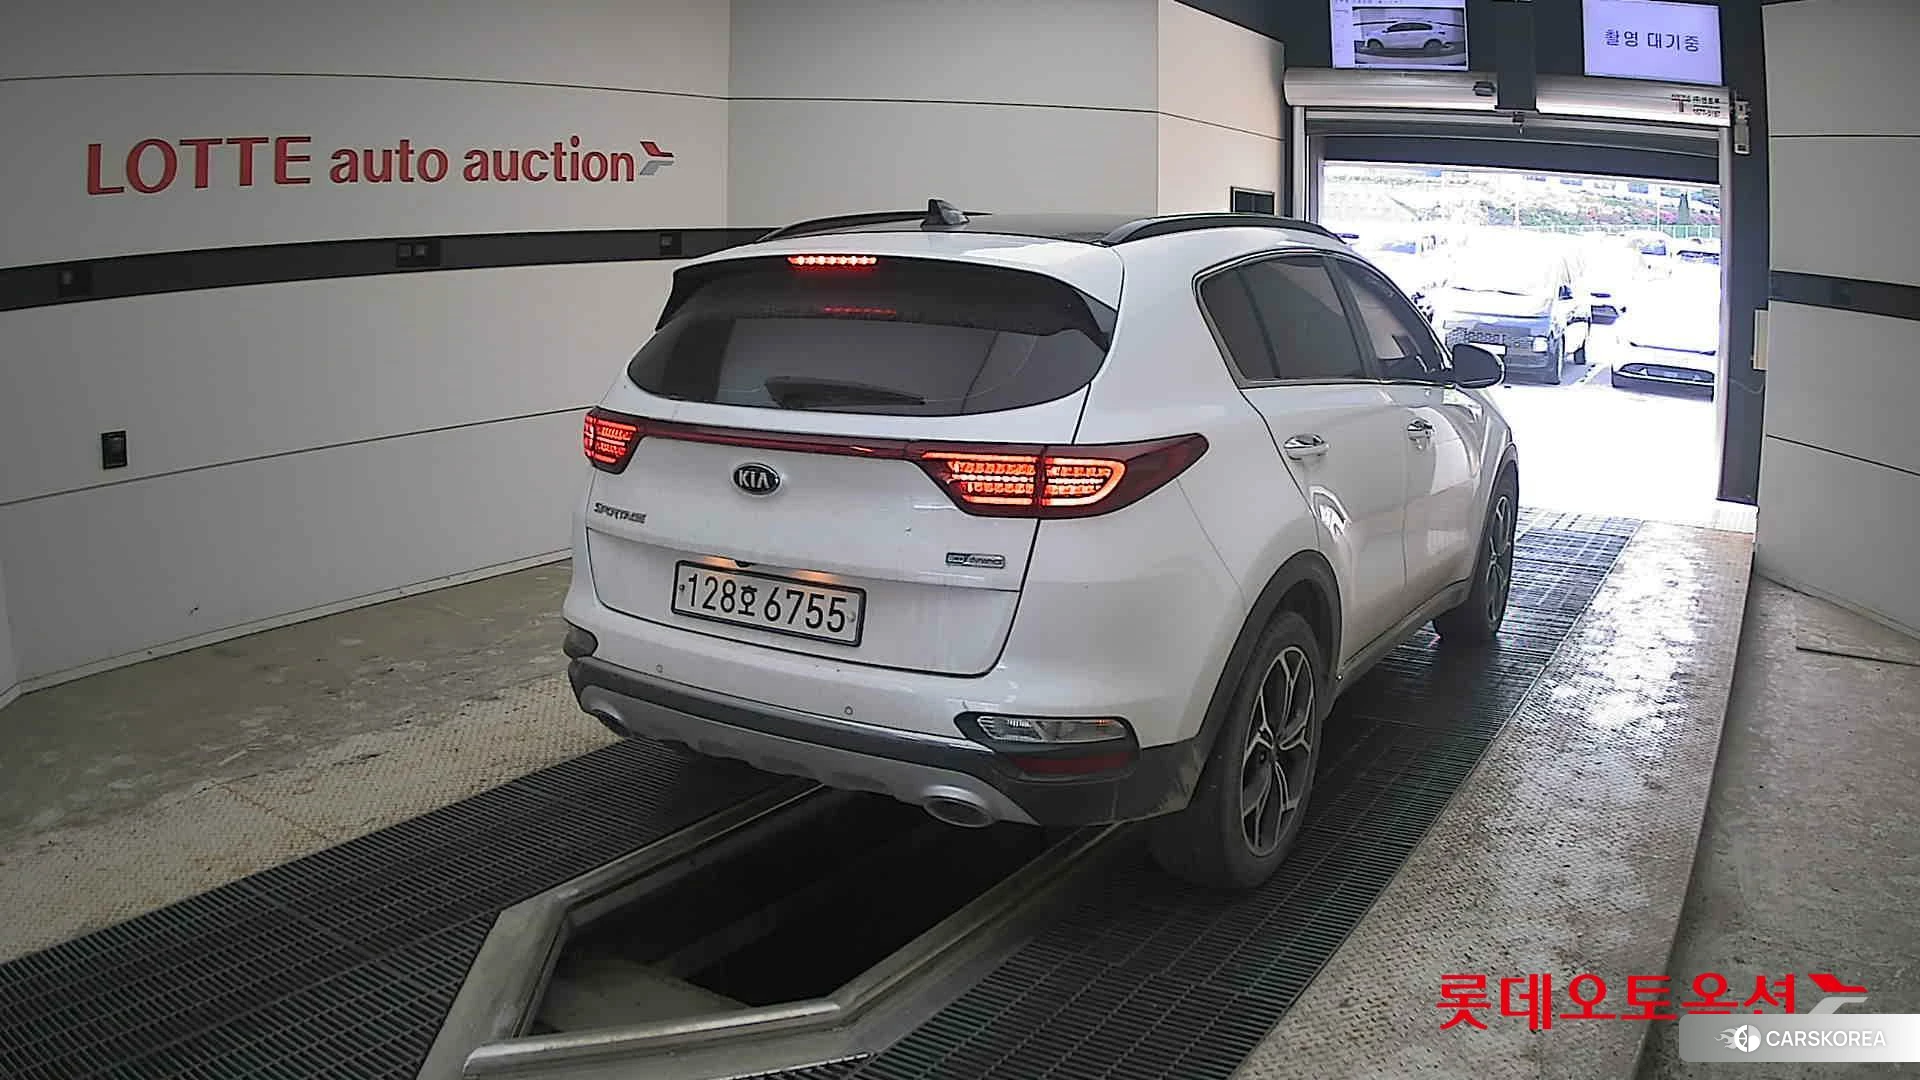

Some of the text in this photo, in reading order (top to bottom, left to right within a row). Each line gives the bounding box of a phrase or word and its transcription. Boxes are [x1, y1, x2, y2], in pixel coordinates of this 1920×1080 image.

[1646, 31, 1700, 53] 대기중
[86, 135, 637, 196] LOTTE auto auction
[738, 469, 771, 489] KIA
